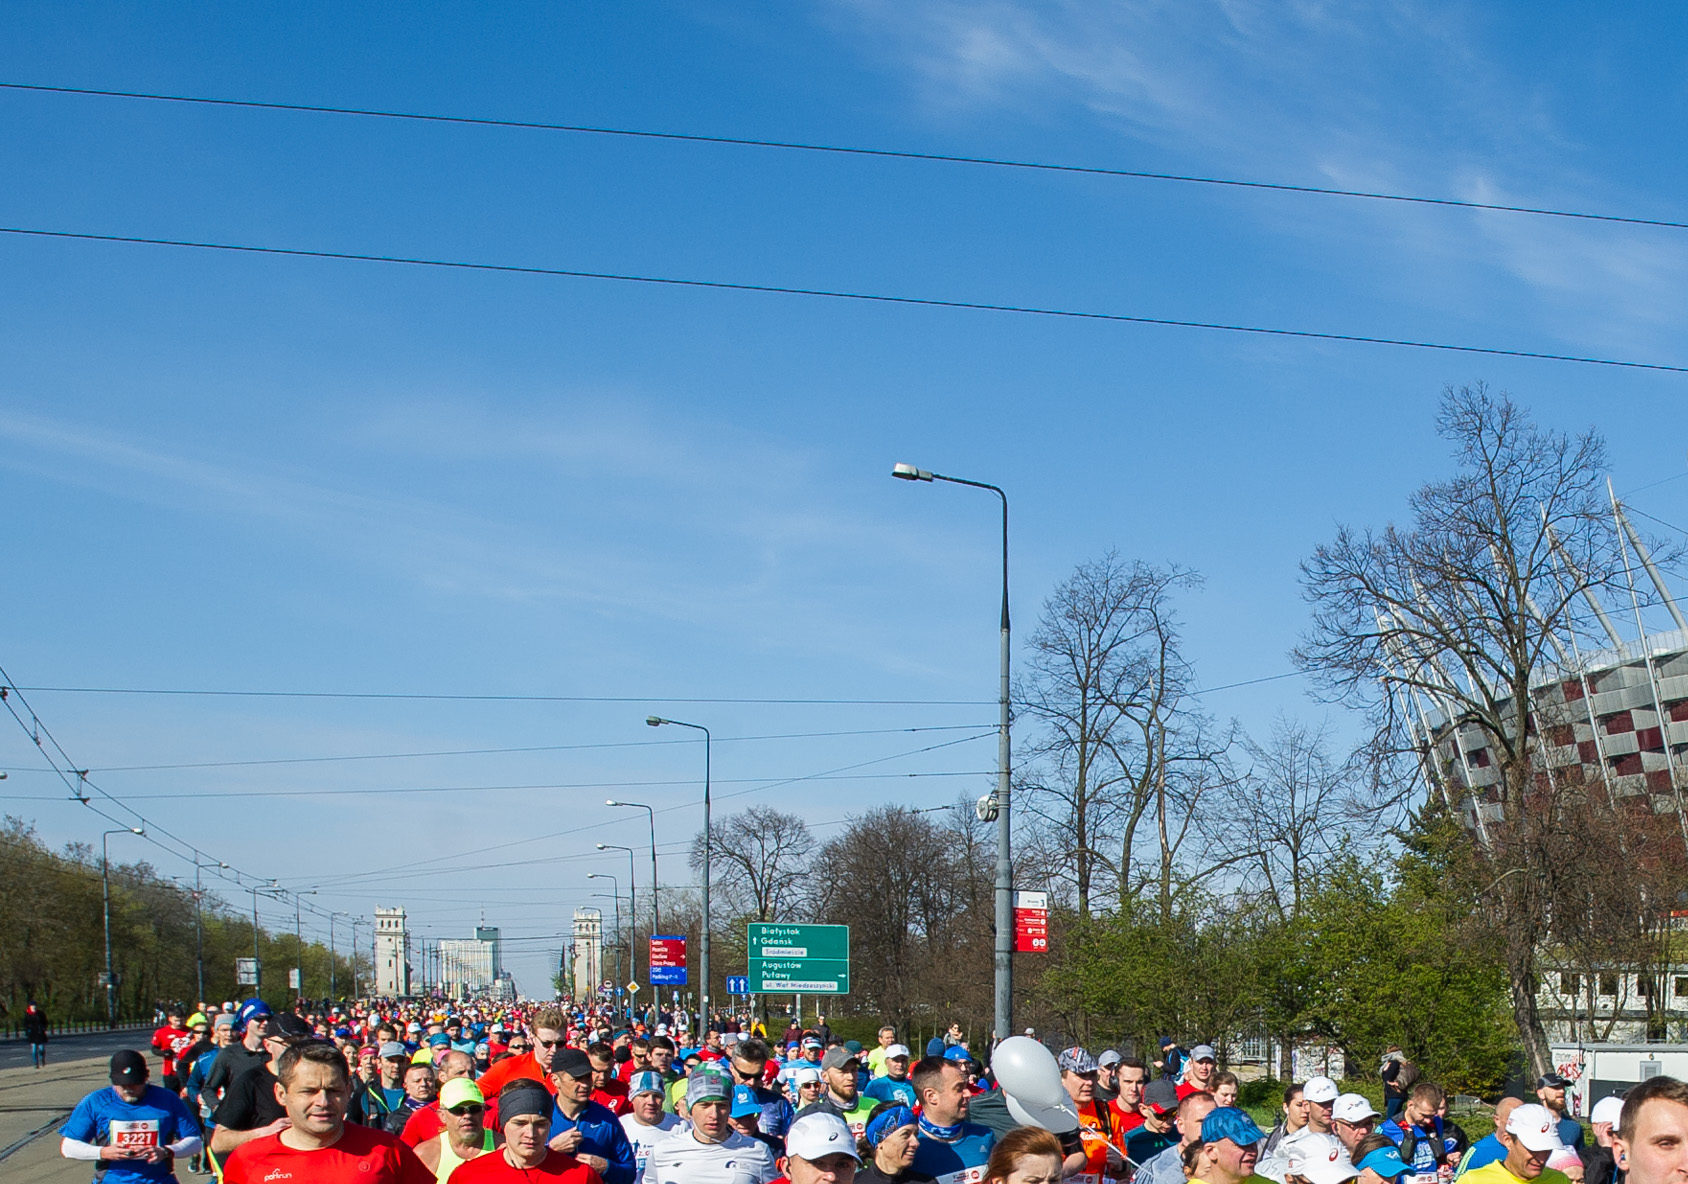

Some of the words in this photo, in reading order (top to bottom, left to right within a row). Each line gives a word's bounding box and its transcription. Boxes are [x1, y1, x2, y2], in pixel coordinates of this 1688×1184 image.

[761, 926, 800, 936] Białystok
[761, 937, 793, 945] Gdańsk
[762, 961, 802, 970] Augustów
[762, 971, 791, 980] Puławy
[122, 1132, 152, 1146] 3221
